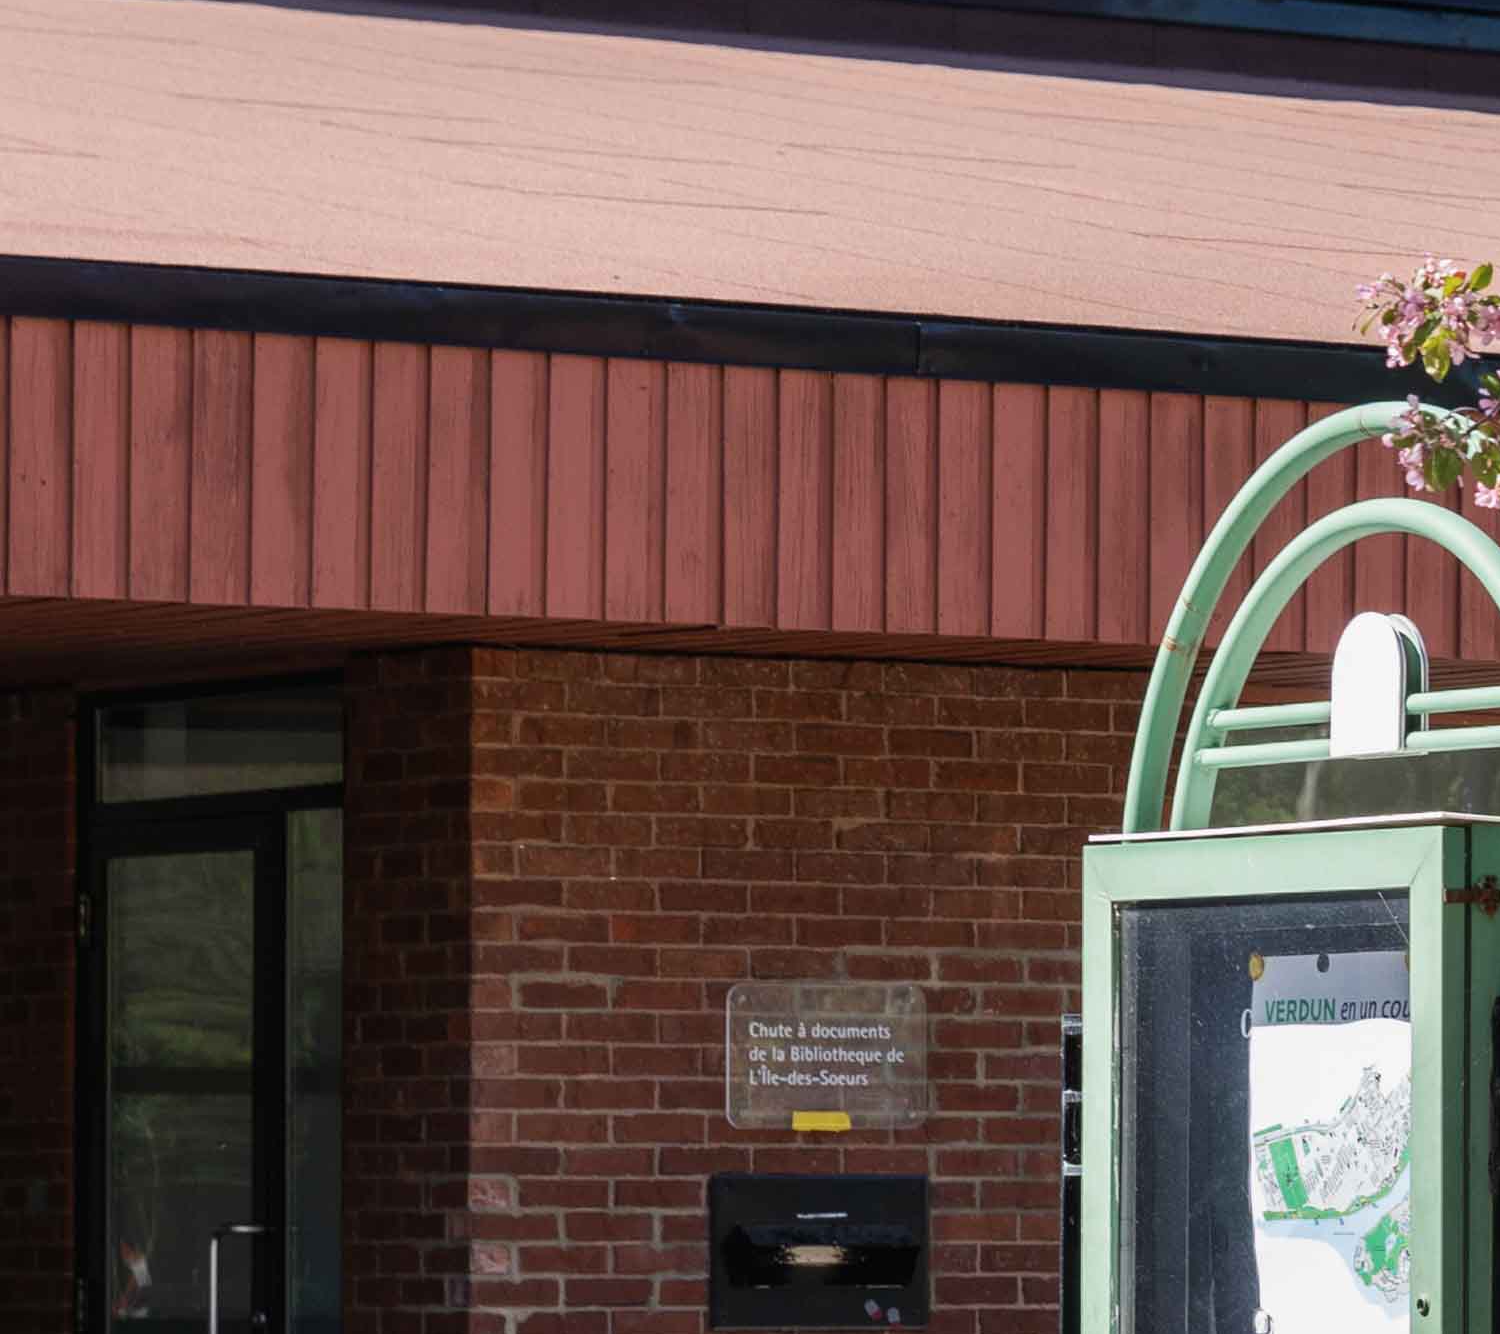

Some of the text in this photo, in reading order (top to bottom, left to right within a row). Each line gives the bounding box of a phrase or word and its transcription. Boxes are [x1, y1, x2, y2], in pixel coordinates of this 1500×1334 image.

[1265, 998, 1336, 1022] VERDUN
[1341, 1001, 1356, 1020] en
[1360, 999, 1377, 1019] un
[749, 1021, 891, 1040] Chute à documents
[749, 1046, 767, 1062] de
[772, 1046, 785, 1062] la
[886, 1047, 905, 1063] de
